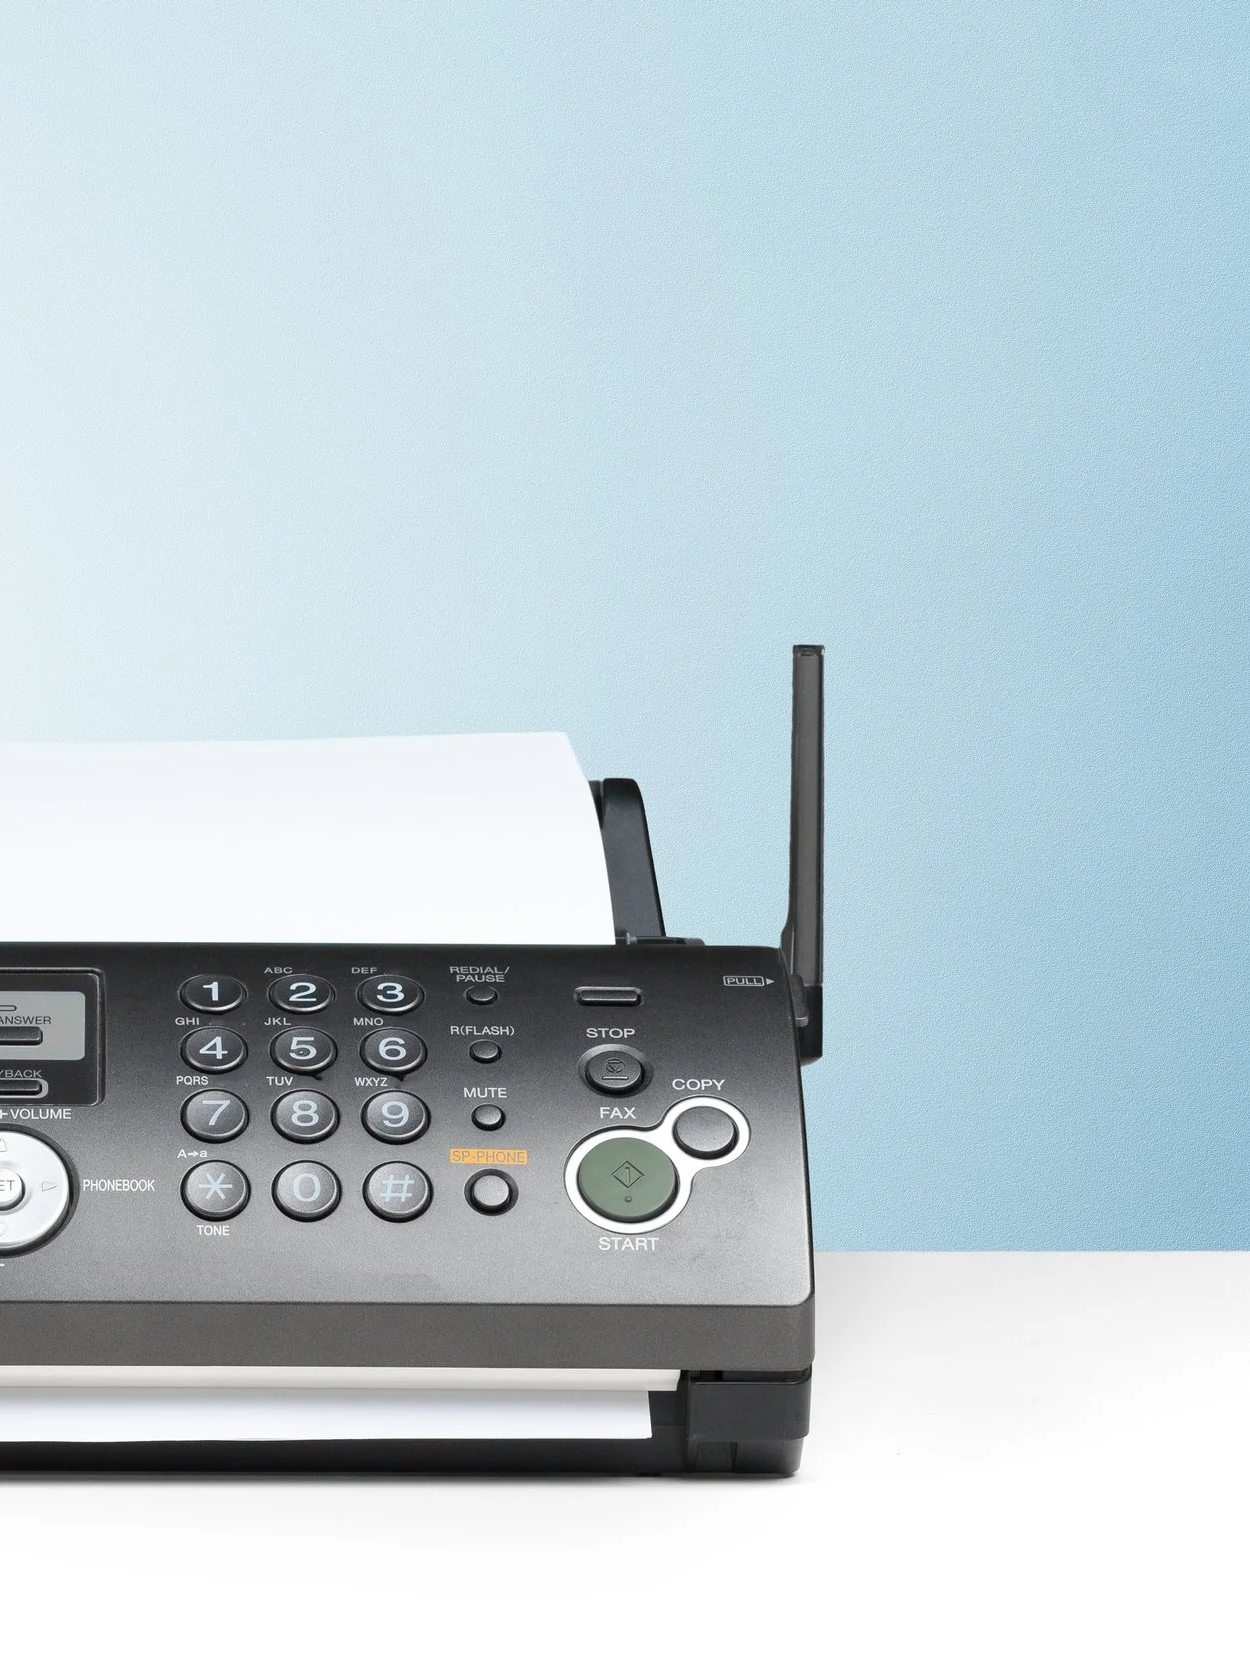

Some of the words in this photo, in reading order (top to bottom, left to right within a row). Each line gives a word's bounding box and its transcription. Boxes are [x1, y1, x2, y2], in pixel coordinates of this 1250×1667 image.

[450, 966, 510, 974] REDIAL/
[456, 974, 505, 982] PAUSE
[726, 977, 762, 985] PULL
[202, 982, 220, 1001] 1
[289, 982, 317, 1001] 2
[376, 982, 405, 1002] 3
[450, 1026, 515, 1036] R(FLASH)
[586, 1028, 635, 1038] STOP
[199, 1037, 227, 1060] 4
[289, 1037, 317, 1060] 5
[378, 1037, 406, 1060] 6
[176, 1076, 208, 1086] PQRS
[266, 1077, 293, 1086] TUV
[355, 1077, 388, 1087] WXYZ
[672, 1079, 725, 1091] COPY
[464, 1088, 507, 1098] MUTE
[202, 1100, 230, 1126] 7
[291, 1101, 319, 1126] 8
[381, 1102, 409, 1128] 9
[600, 1107, 636, 1119] FAX
[452, 1150, 526, 1163] SP-PHONE
[83, 1180, 155, 1192] PHONEBOOK
[293, 1174, 321, 1202] 0
[196, 1226, 229, 1236] TONE
[599, 1237, 659, 1250] START
